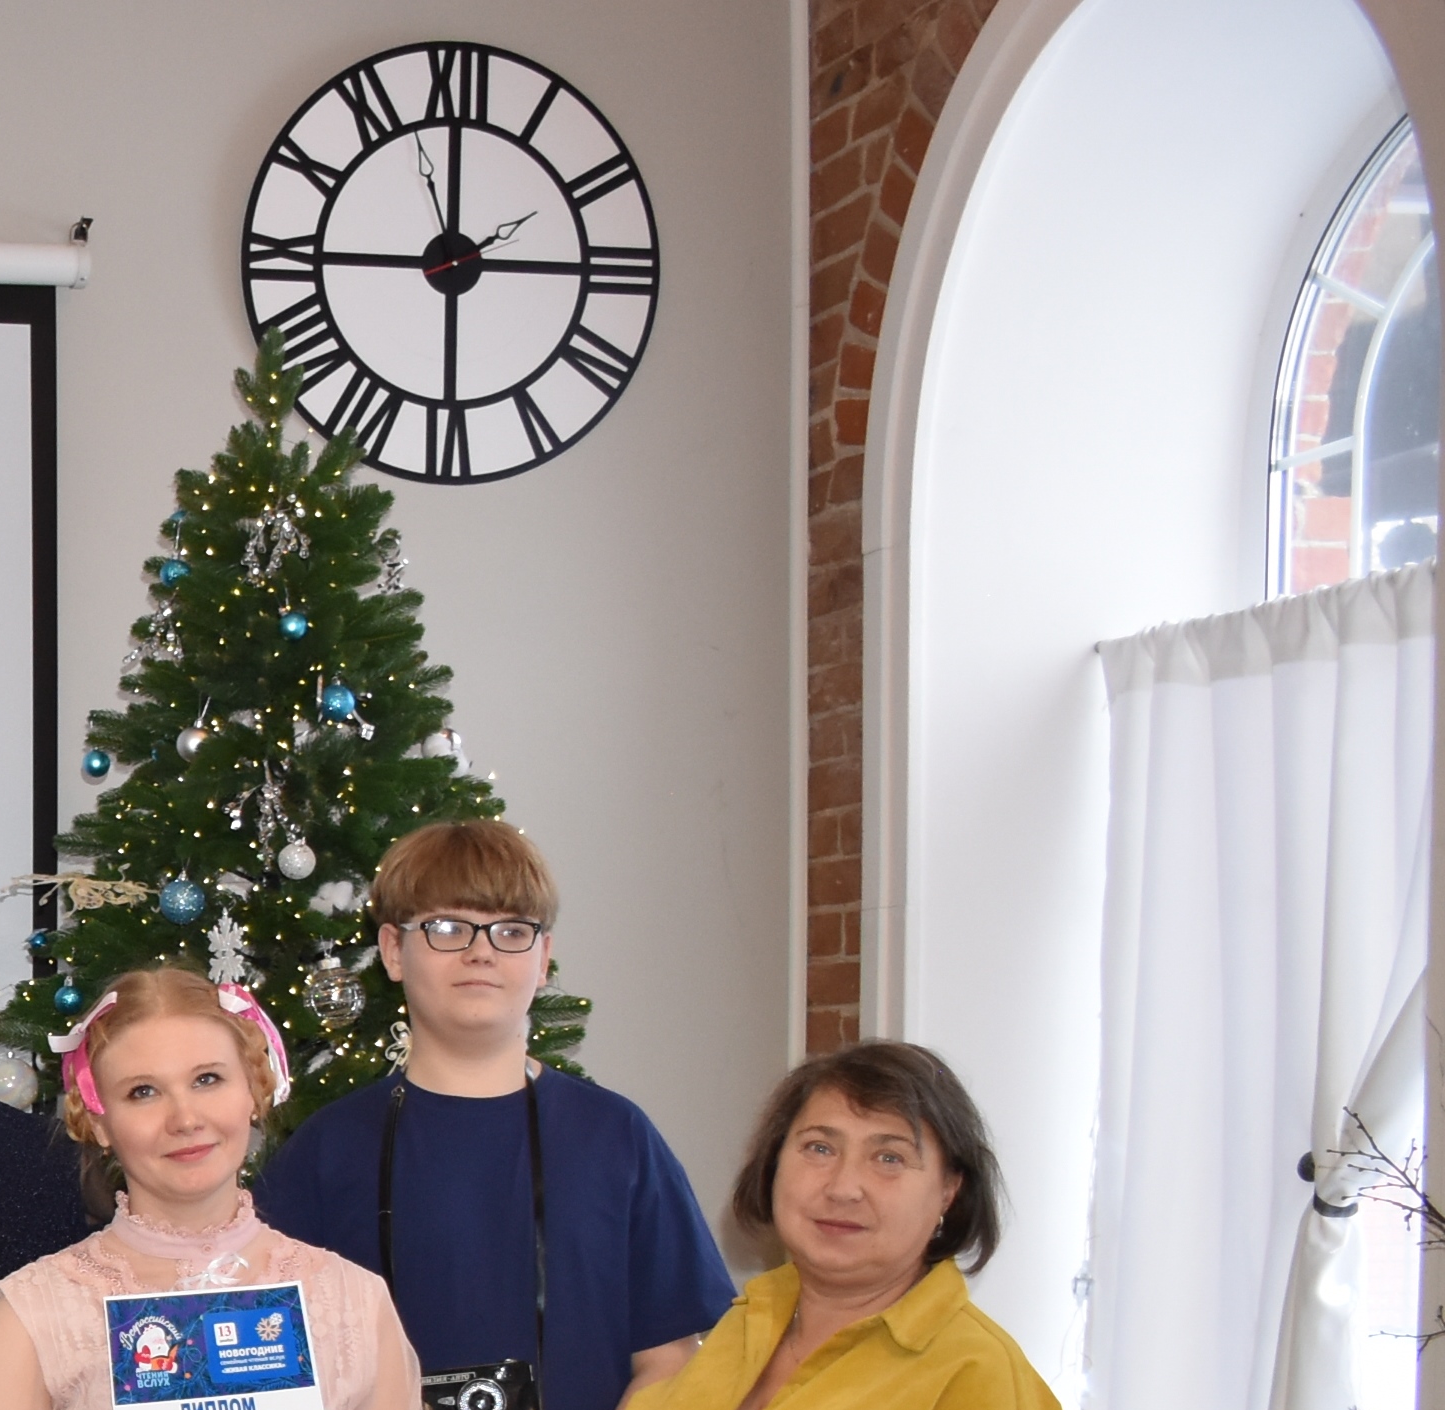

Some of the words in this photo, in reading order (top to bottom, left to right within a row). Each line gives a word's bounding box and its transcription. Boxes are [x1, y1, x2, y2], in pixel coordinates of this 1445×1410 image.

[218, 1325, 232, 1336] 13
[218, 1344, 284, 1359] НОВОГОДНИЕ
[221, 1365, 251, 1373] «ЖИВАЯ
[251, 1362, 286, 1371] КЛАССИКА»
[136, 1370, 169, 1379] ЧТЕНИЯ
[137, 1376, 170, 1388] ВСЛУХ
